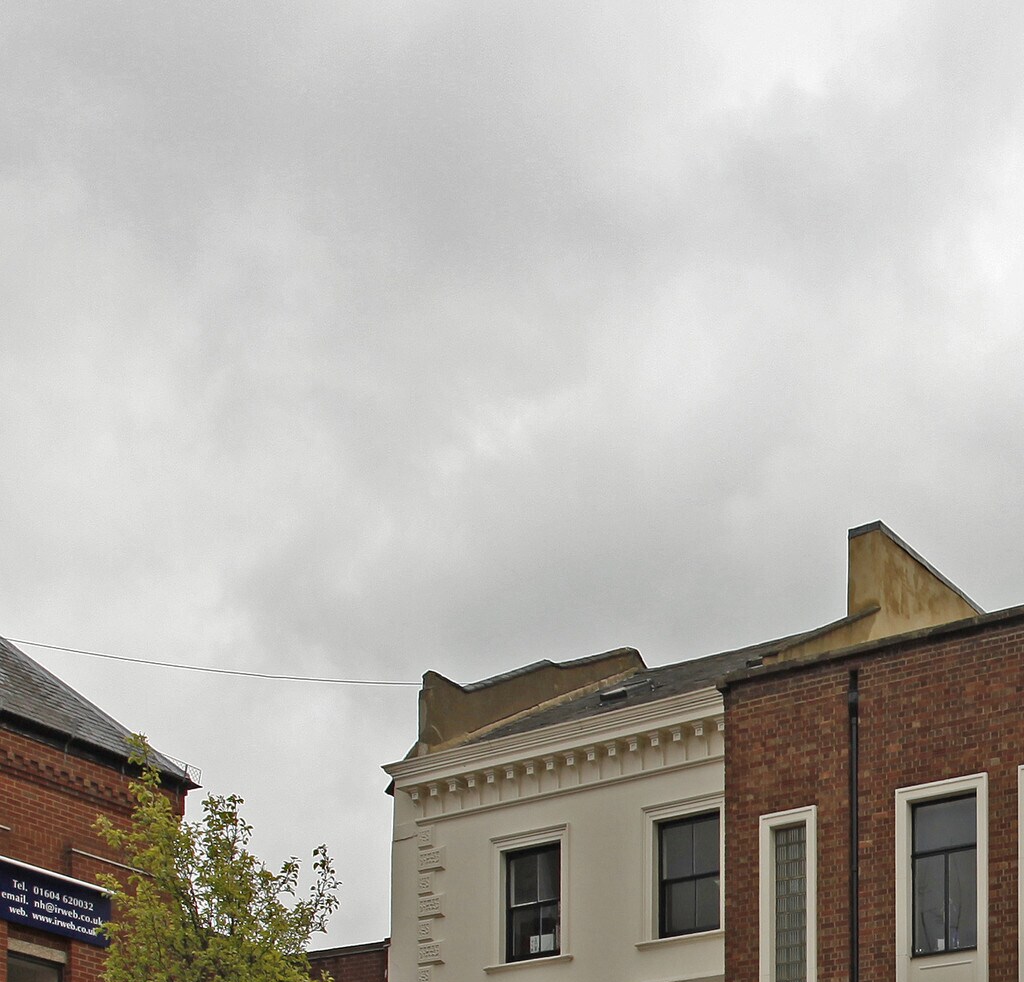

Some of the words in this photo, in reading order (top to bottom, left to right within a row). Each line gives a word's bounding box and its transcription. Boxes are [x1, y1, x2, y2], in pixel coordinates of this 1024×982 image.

[1, 891, 29, 905] email.
[34, 900, 103, 926] nh@irweb.co.uk
[12, 879, 28, 892] Tel.
[33, 886, 60, 901] 01604
[62, 894, 94, 911] 620032
[9, 906, 28, 917] web.
[32, 912, 98, 936] www.irweb.co.uk
